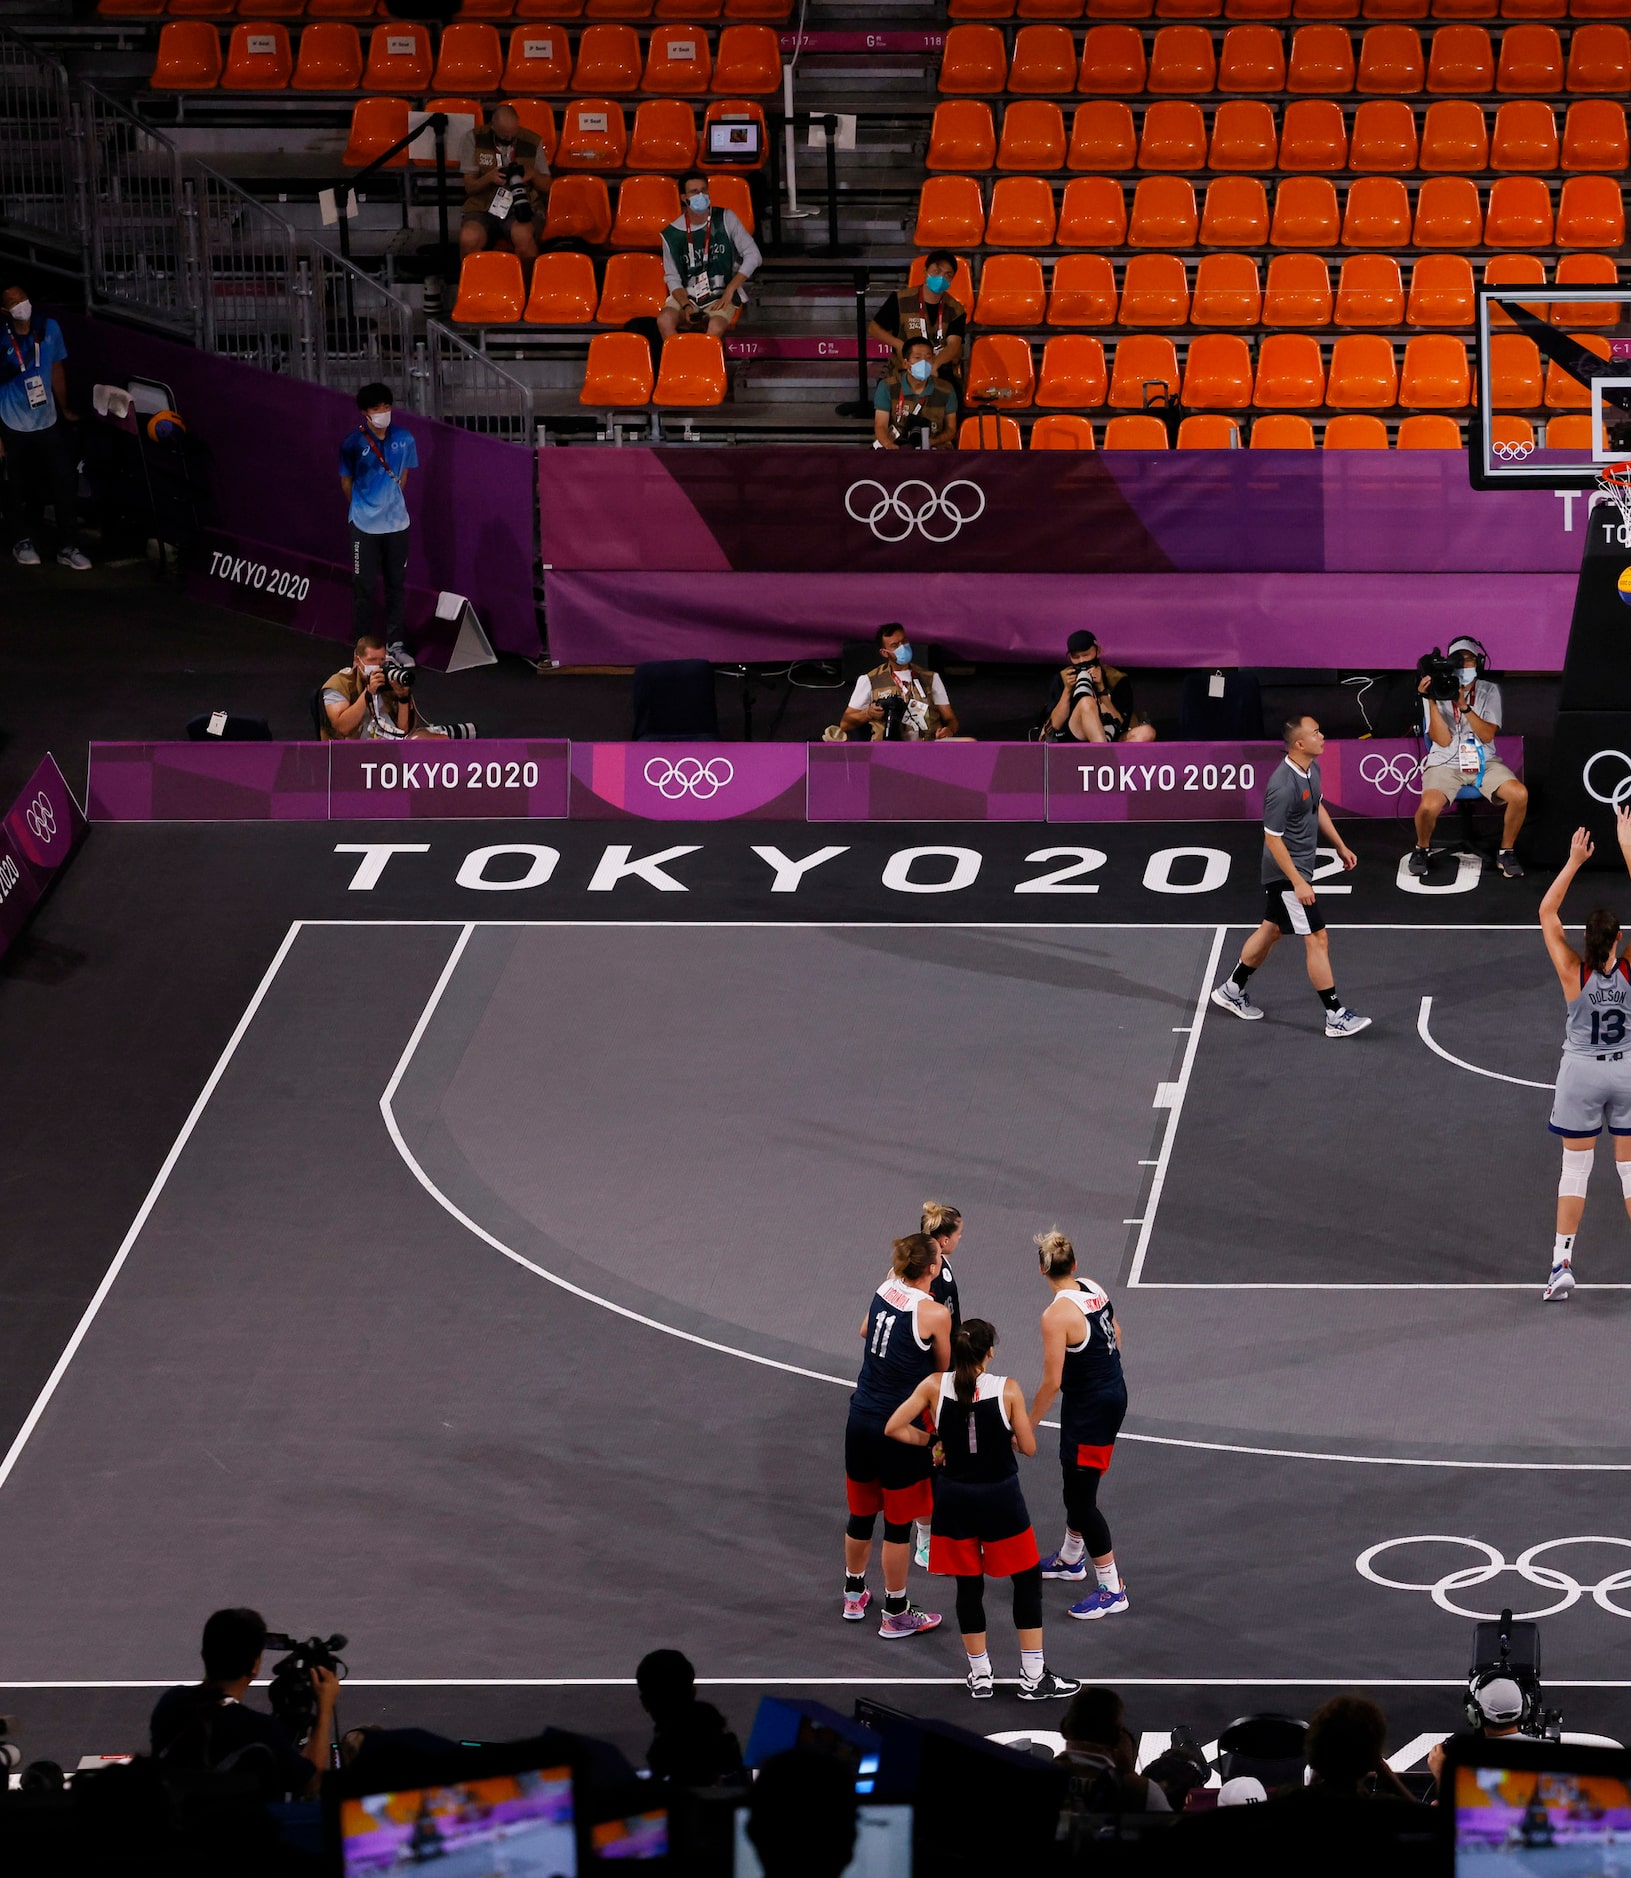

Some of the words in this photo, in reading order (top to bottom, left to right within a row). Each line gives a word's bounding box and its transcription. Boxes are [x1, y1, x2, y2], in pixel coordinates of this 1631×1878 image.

[792, 36, 808, 45] 17
[867, 35, 875, 47] G
[924, 36, 942, 46] 118
[740, 344, 758, 352] 117
[818, 342, 826, 354] C
[878, 344, 892, 353] 11
[210, 551, 267, 588] TOKYO
[266, 569, 310, 601] 2020
[361, 762, 459, 789] TOKYO
[467, 761, 538, 788] 2020
[1077, 765, 1175, 791] TOKYO
[1183, 764, 1255, 791] 2020
[1588, 989, 1627, 1005] DOLSON
[1590, 1009, 1626, 1045] 13
[870, 1310, 896, 1358] 11
